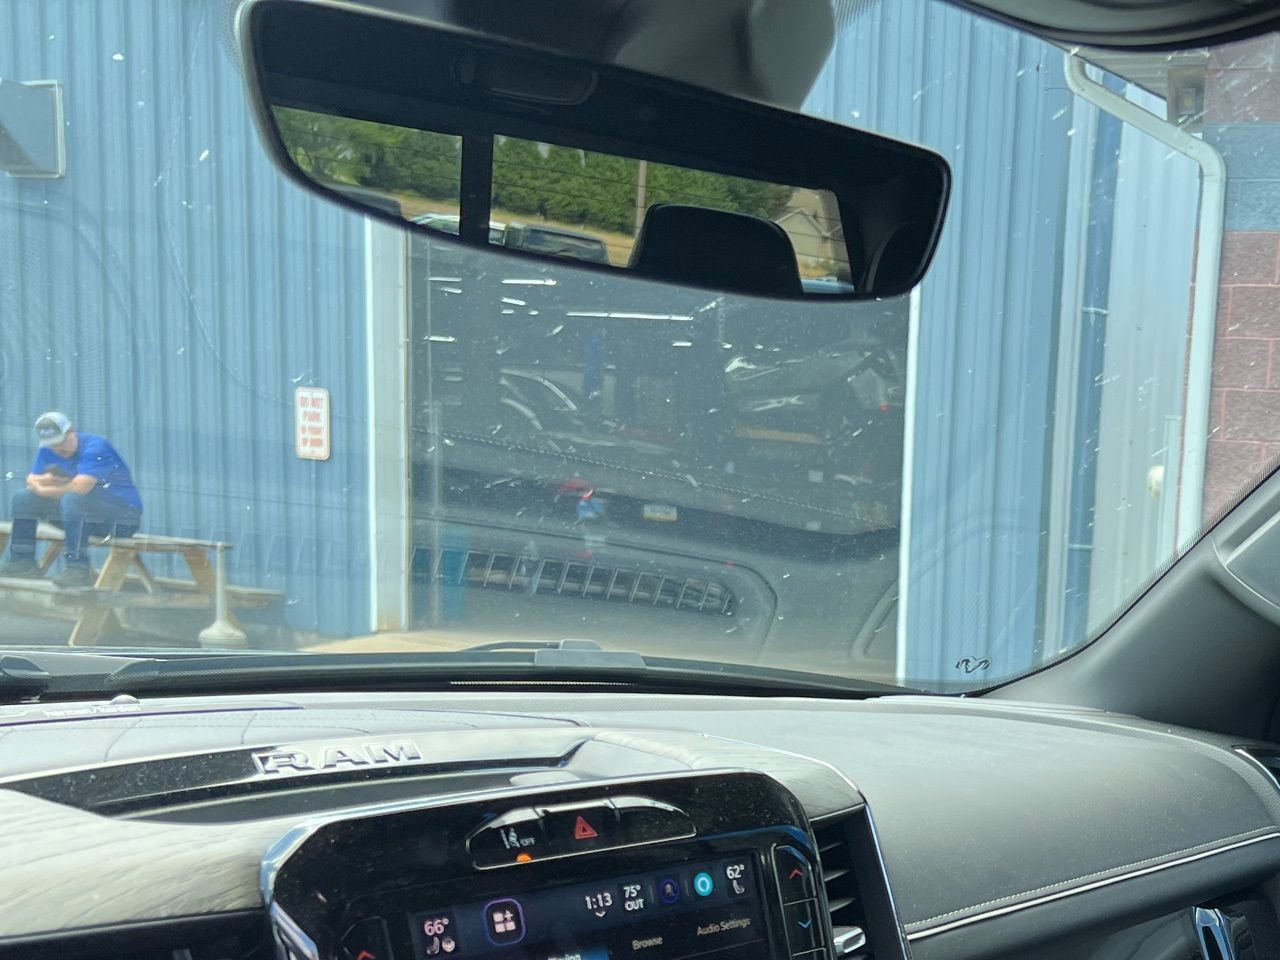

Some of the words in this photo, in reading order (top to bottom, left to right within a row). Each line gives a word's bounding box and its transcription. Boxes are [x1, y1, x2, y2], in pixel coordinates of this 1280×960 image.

[252, 740, 421, 775] RAM
[584, 892, 613, 910] 1:13
[624, 898, 645, 912] OUT
[696, 923, 720, 936] Audio
[720, 917, 751, 932] Settings
[631, 935, 664, 950] Browse
